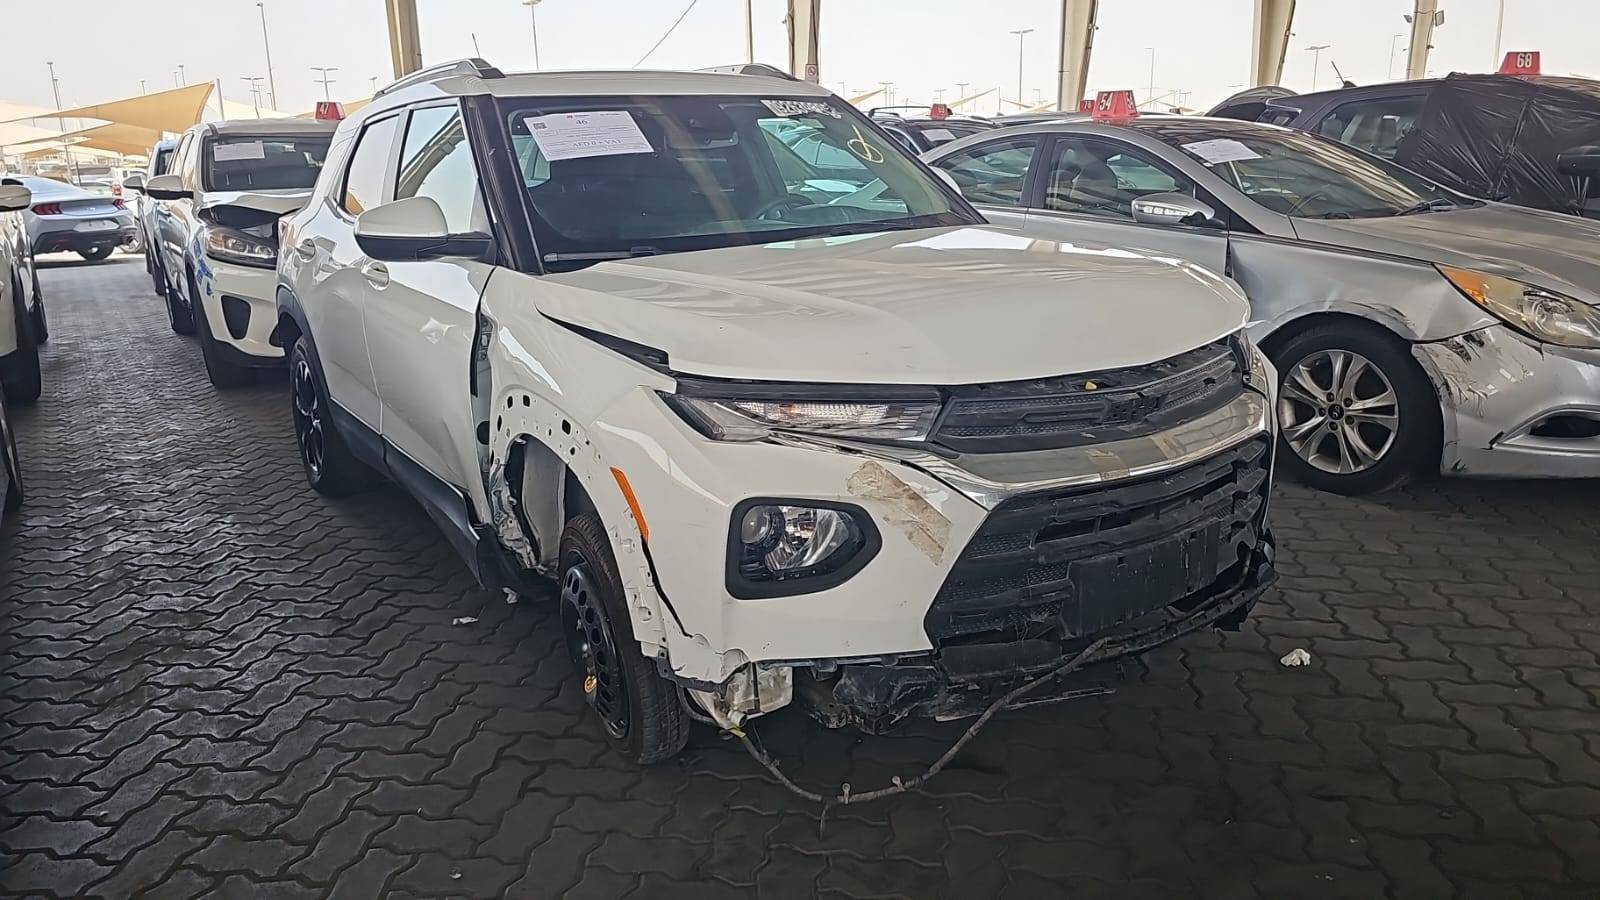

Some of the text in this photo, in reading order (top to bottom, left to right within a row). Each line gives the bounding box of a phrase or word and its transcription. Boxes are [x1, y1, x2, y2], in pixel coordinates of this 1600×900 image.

[1516, 53, 1532, 68] 68
[320, 102, 329, 115] 47
[1099, 92, 1113, 111] 54
